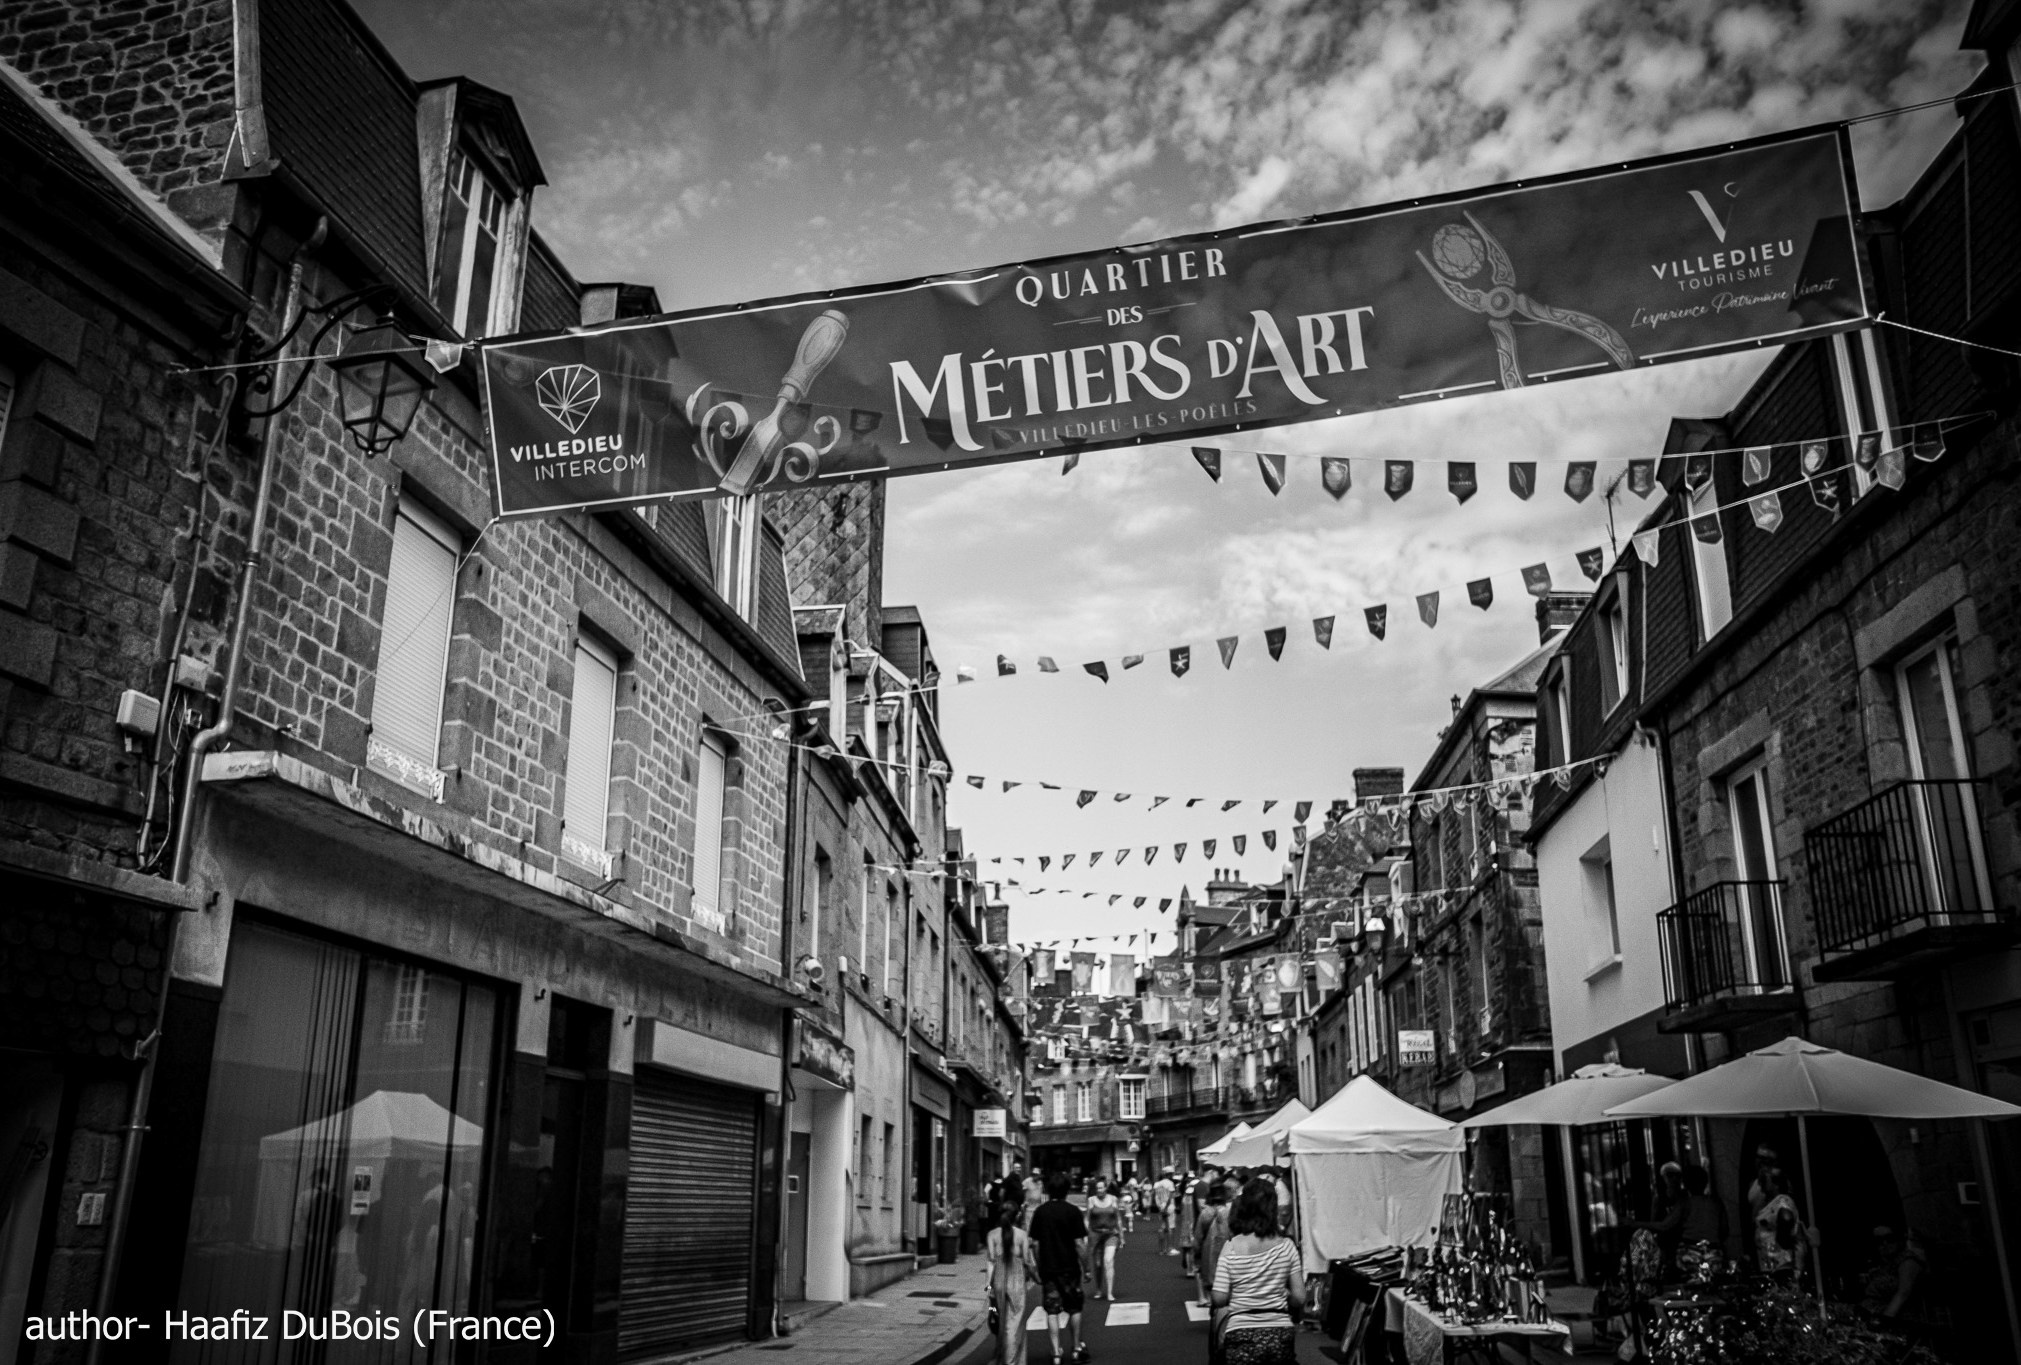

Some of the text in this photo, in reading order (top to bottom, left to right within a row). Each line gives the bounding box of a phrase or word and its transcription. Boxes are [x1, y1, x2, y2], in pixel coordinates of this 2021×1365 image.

[1015, 247, 1228, 307] QUARTIER
[1651, 239, 1795, 280] VILLEDIEU
[1677, 264, 1774, 291] TOURISME
[1711, 290, 1790, 313] Patrimoine
[1792, 277, 1841, 301] Vivant
[1106, 304, 1144, 326] DES
[888, 305, 1376, 452] MÉTIERS D'ART
[1019, 400, 1258, 445] VILLEDIEU-LES-POÊLES
[510, 433, 623, 462] VILLEDIEU
[534, 453, 646, 482] INTERCOM
